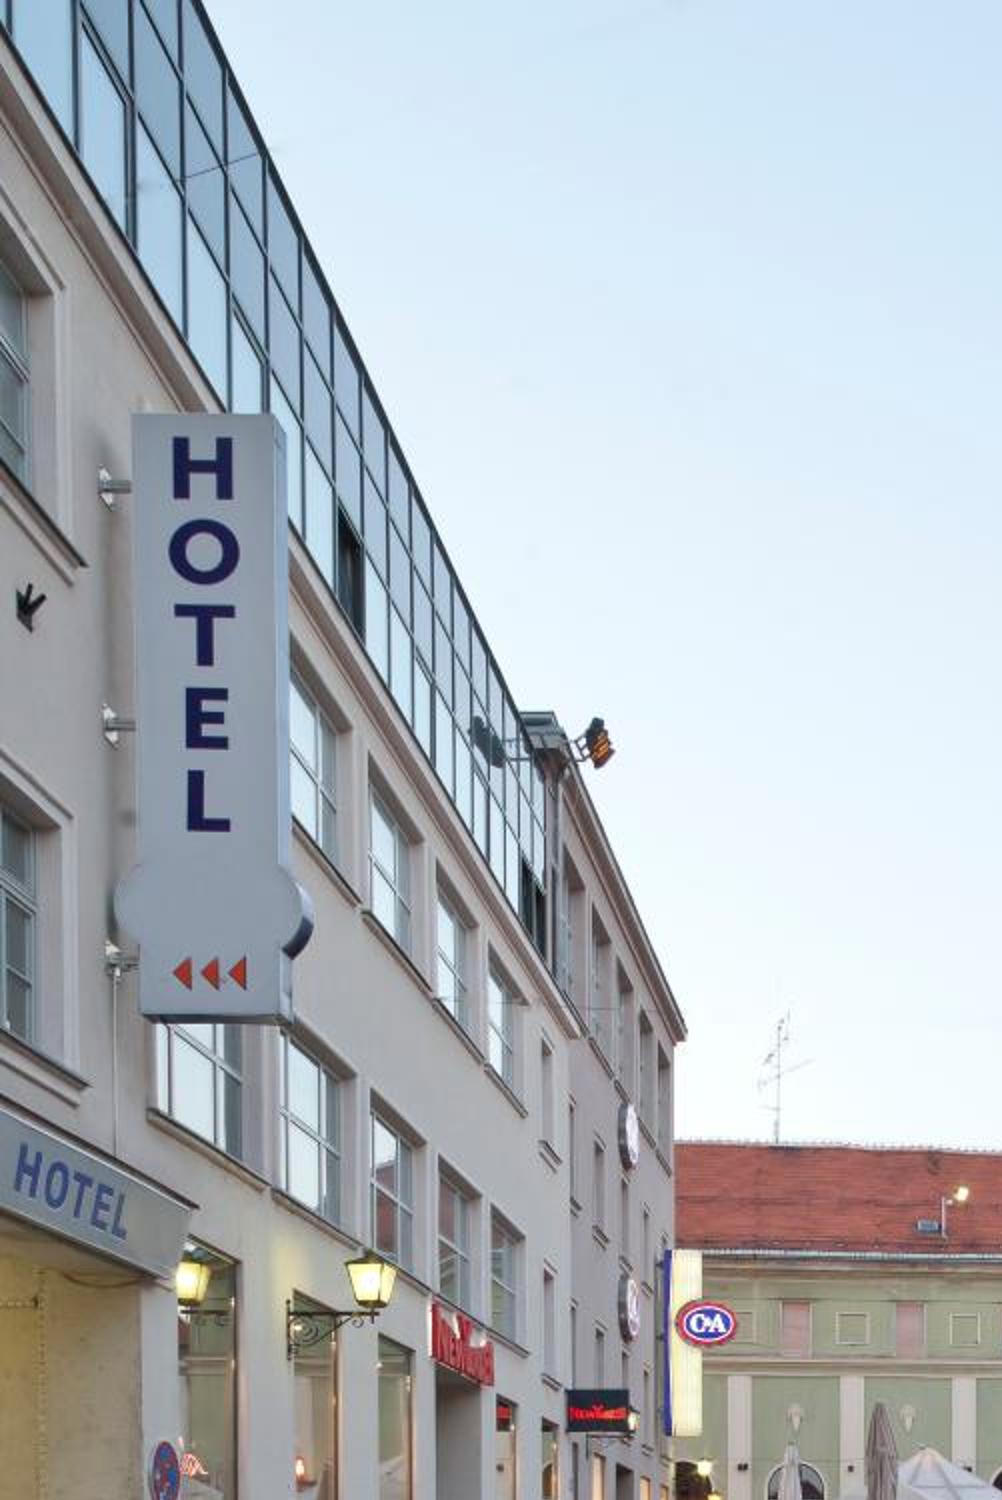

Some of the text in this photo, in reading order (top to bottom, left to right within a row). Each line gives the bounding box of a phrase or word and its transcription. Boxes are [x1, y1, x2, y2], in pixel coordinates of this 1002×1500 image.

[168, 436, 240, 832] HOTEL
[14, 1142, 128, 1240] HOTEL
[690, 1313, 727, 1333] C&A
